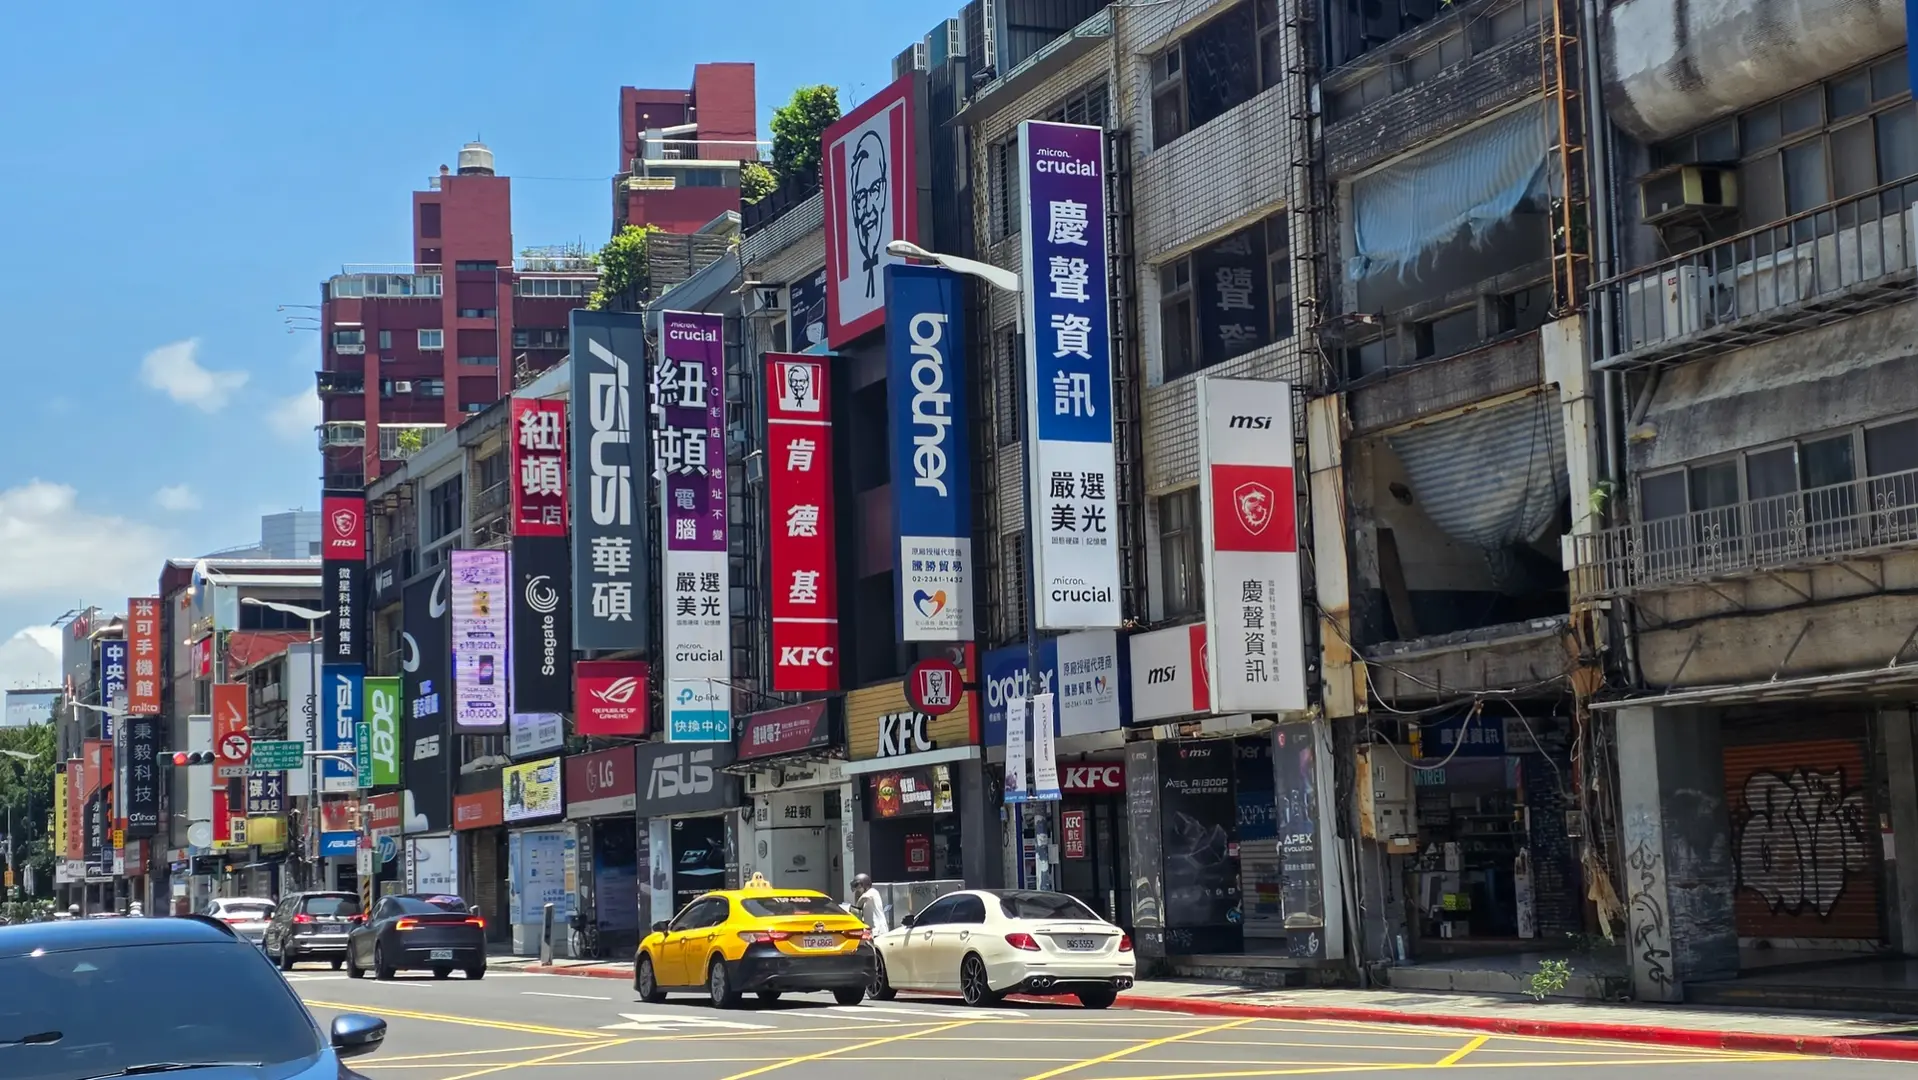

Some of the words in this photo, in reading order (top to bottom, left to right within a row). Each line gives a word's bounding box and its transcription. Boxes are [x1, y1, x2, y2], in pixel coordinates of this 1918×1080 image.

[1036, 148, 1072, 158] micron
[1036, 159, 1097, 176] crucial
[1048, 199, 1095, 418] 慶聲資訊
[669, 330, 718, 342] crucial
[909, 312, 951, 497] brother
[658, 357, 708, 477] 紐頓
[1229, 415, 1272, 430] msi
[589, 338, 632, 526] ASUS
[519, 409, 562, 497] 紐頓
[1050, 471, 1105, 499] 嚴選
[521, 505, 561, 525] 二店
[675, 489, 696, 541] 電腦
[786, 438, 819, 604] 肯德基
[1051, 503, 1106, 532] 美光
[332, 539, 357, 547] msi
[592, 537, 632, 622] 華碩
[676, 572, 720, 593] 嚴選
[1052, 576, 1085, 585] micron
[1051, 586, 1112, 602] crucial
[339, 567, 351, 655] 微星科技展售店
[676, 595, 721, 617] 美光
[1242, 579, 1268, 683] 慶聲資訊
[135, 600, 153, 697] 米可手機館
[542, 615, 557, 676] Seagate
[676, 650, 723, 661] crucial
[778, 646, 834, 666] KFC
[1148, 664, 1175, 685] msi
[336, 673, 353, 738] ASUS
[694, 690, 720, 701] tp-link
[926, 696, 947, 704] KFC
[131, 703, 158, 712] miko
[372, 689, 395, 773] acer
[674, 720, 727, 732] 快換中心
[877, 710, 932, 757] KFC
[1189, 748, 1212, 757] msi
[599, 760, 614, 788] LG
[647, 748, 713, 800] ASUS
[1063, 765, 1120, 789] KFC
[784, 805, 812, 819] 紐頓
[1065, 816, 1081, 828] KFC
[327, 840, 357, 848] ASUS
[1284, 833, 1313, 845] APEX
